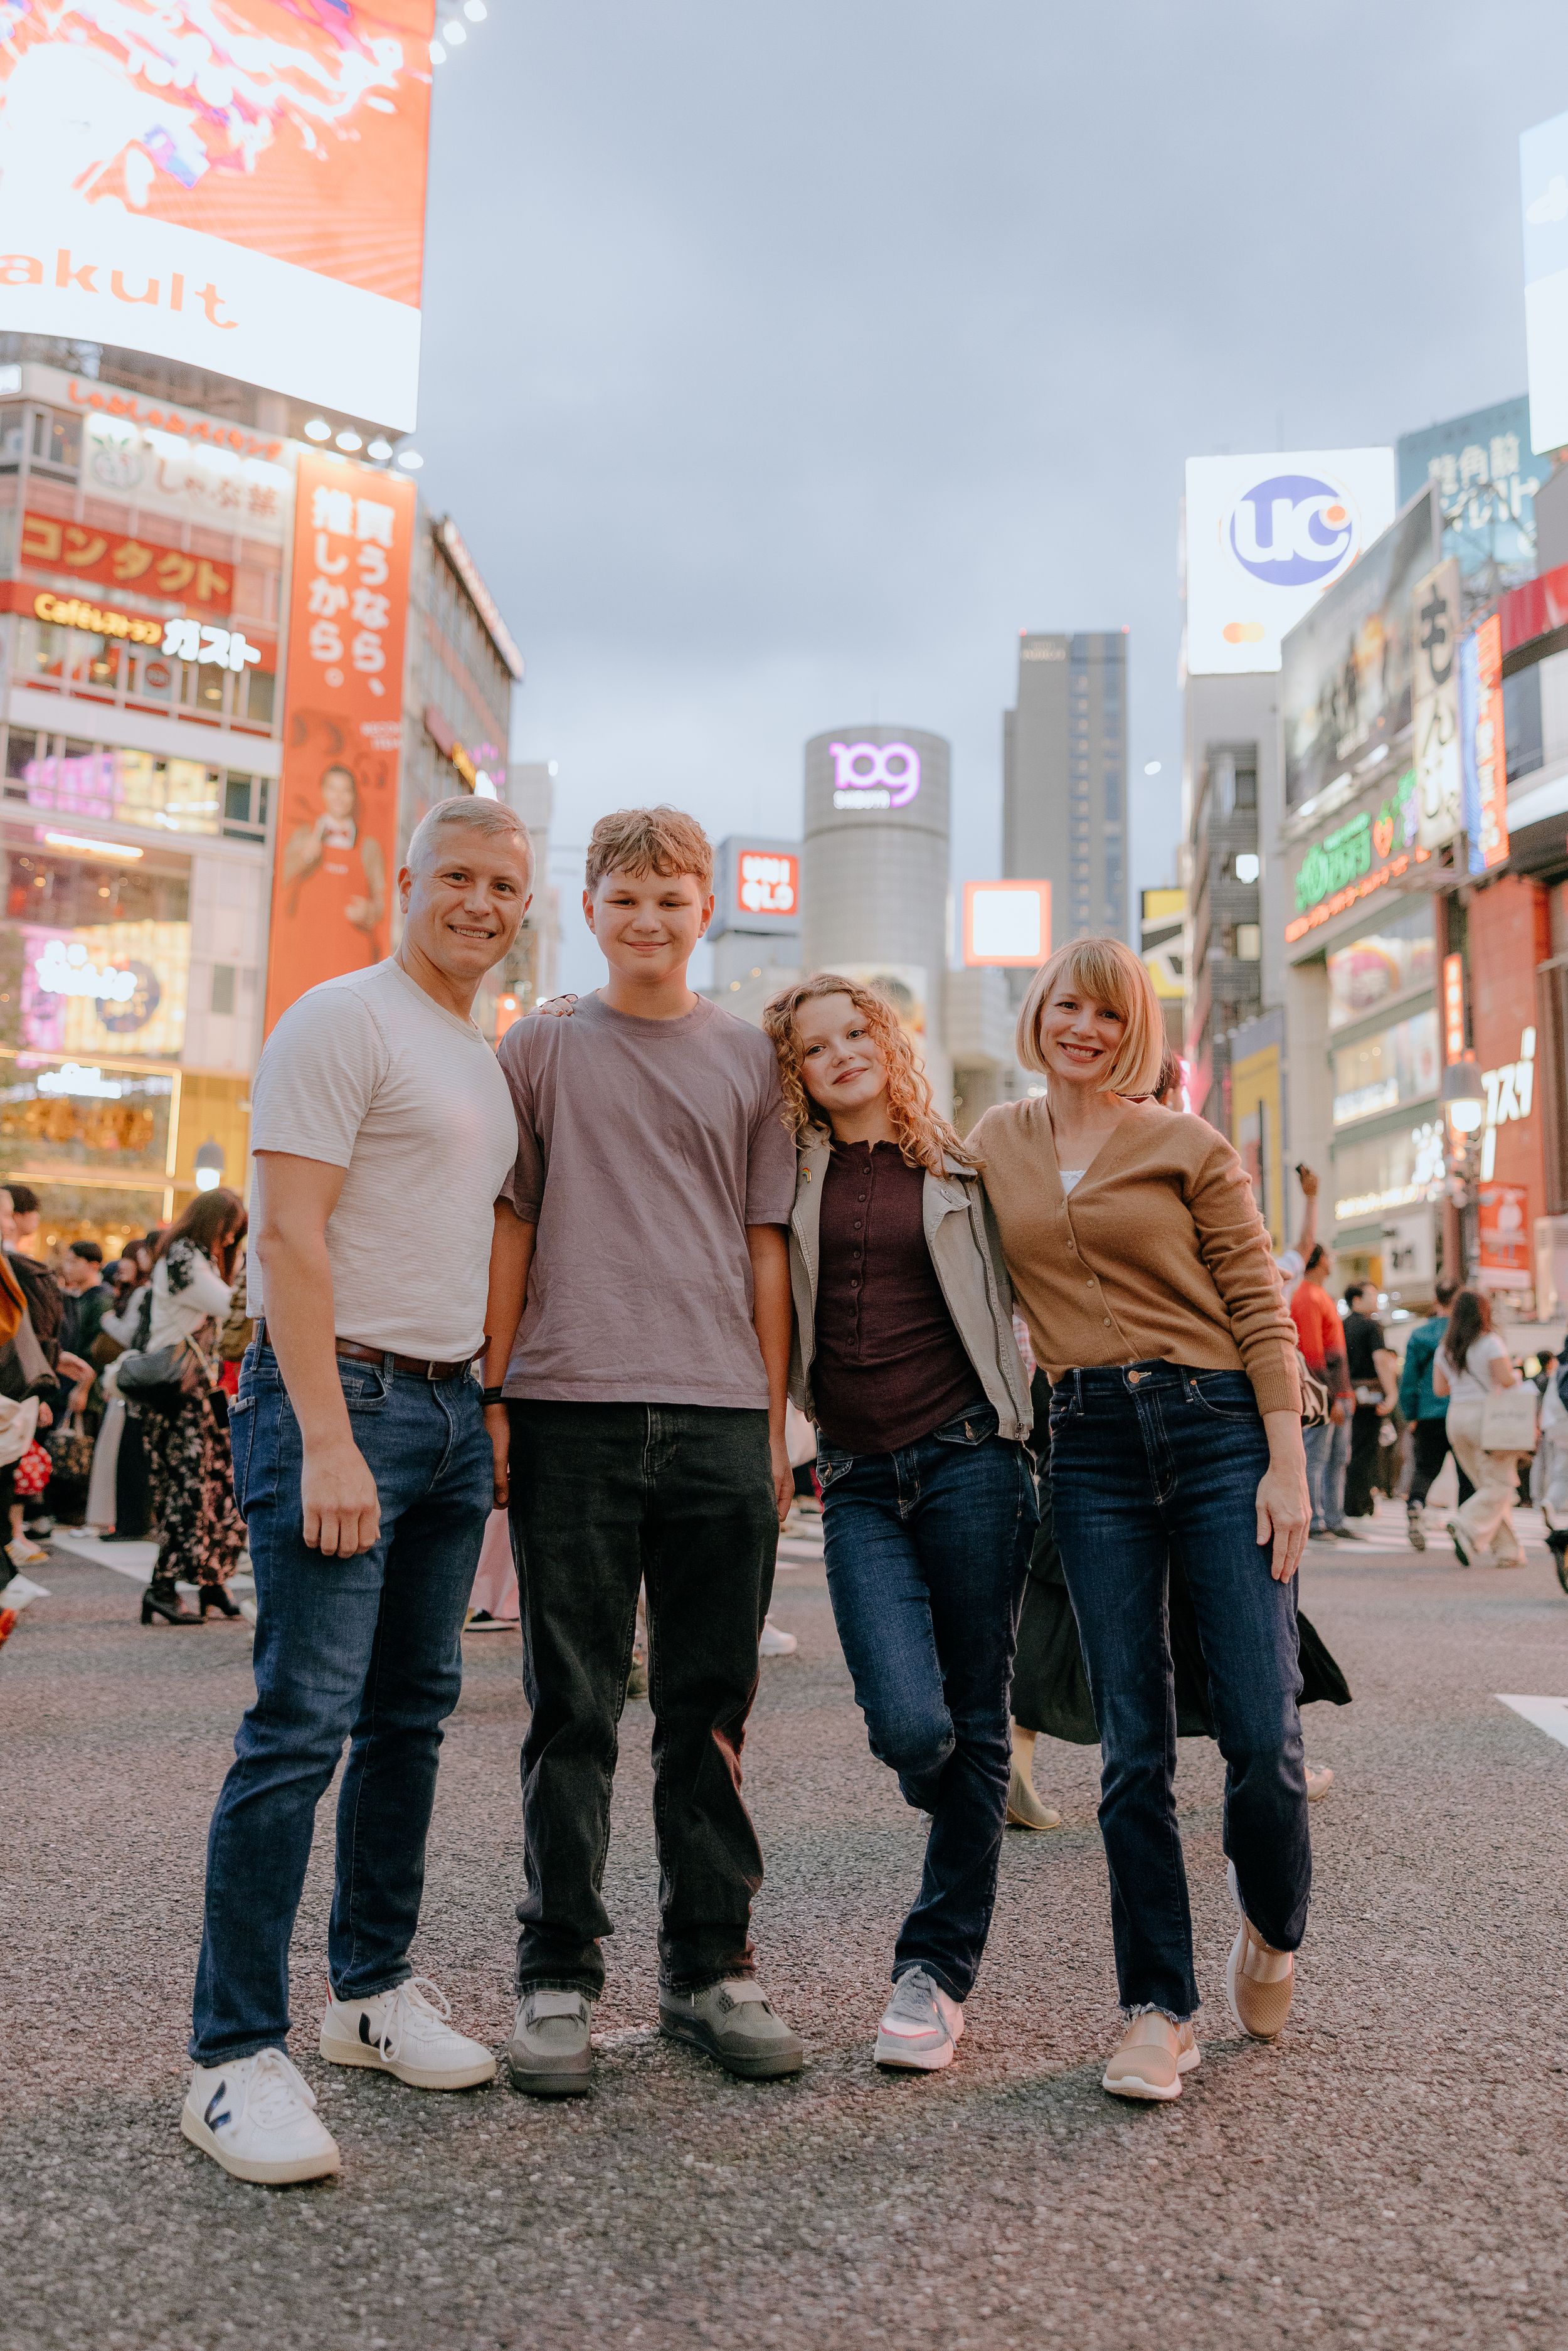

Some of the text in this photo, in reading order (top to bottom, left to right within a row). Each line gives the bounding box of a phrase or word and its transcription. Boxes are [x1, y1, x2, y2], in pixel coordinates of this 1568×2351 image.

[22, 517, 230, 600] コンタクト
[161, 618, 261, 672] ガスト
[828, 741, 921, 809] 109
